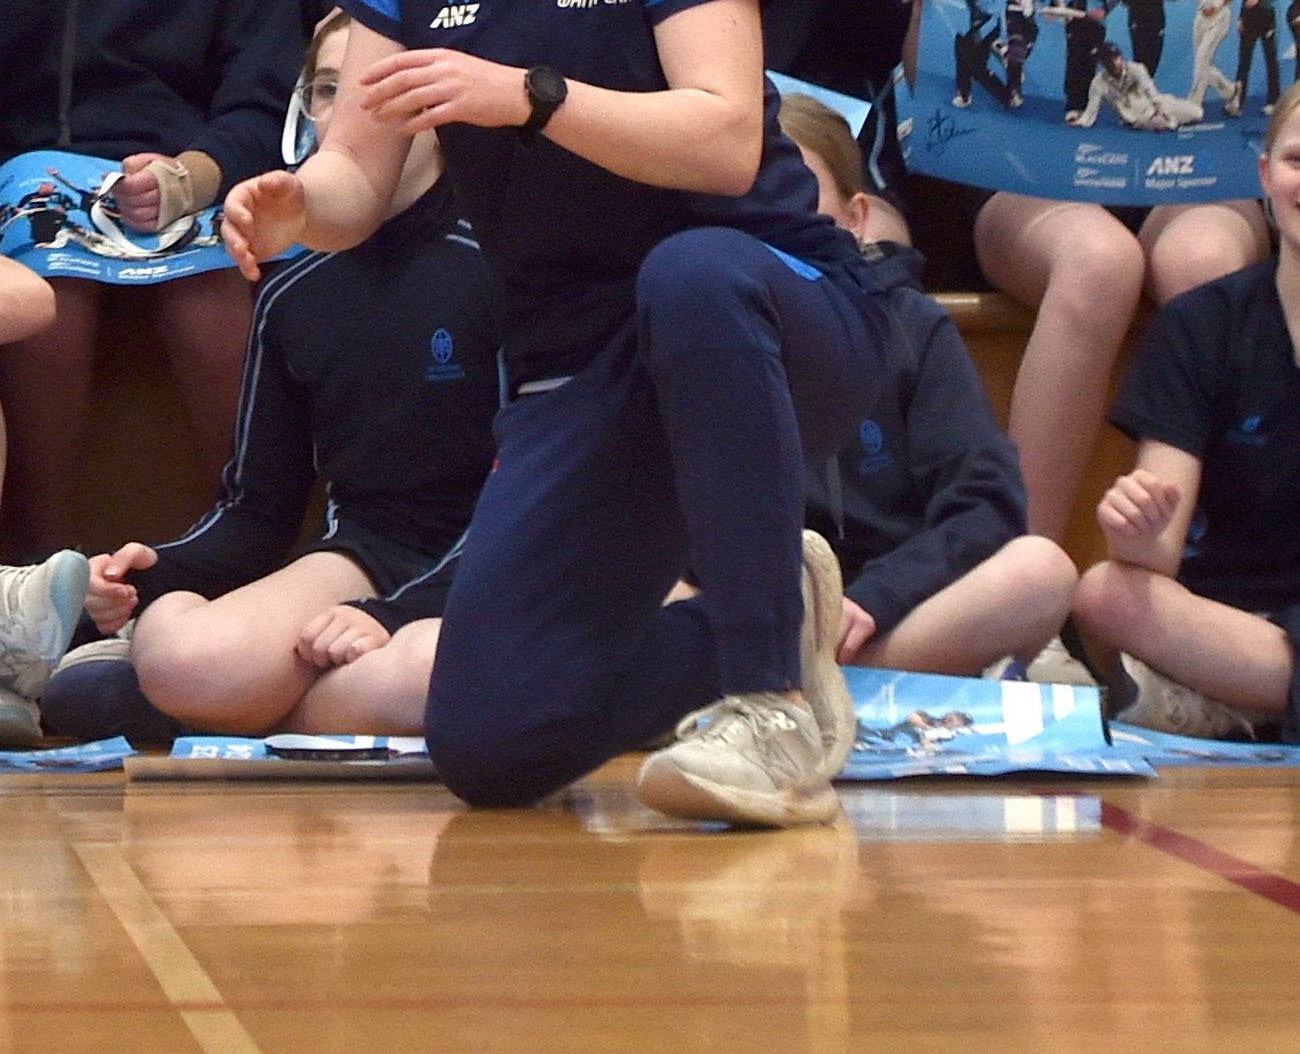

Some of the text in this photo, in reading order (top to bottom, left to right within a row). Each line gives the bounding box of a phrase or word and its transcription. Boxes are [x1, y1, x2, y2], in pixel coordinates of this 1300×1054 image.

[430, 3, 480, 28] ANZ
[1146, 155, 1195, 175] ANZ
[119, 265, 169, 276] ANZ
